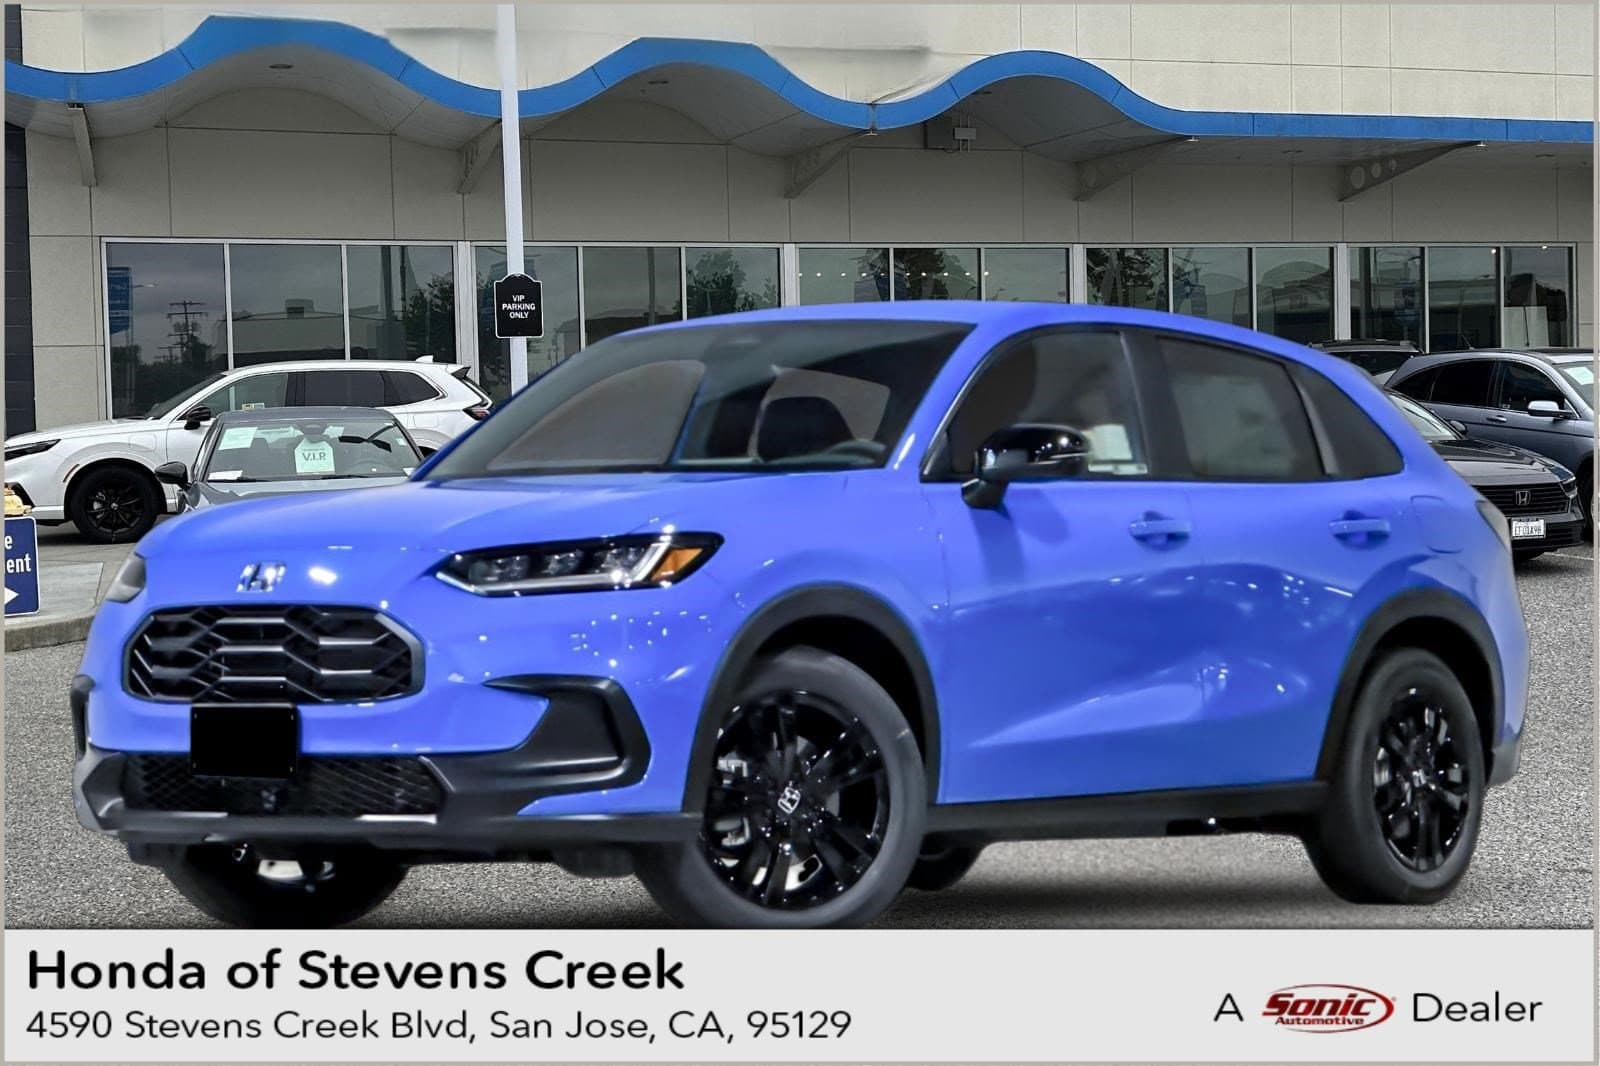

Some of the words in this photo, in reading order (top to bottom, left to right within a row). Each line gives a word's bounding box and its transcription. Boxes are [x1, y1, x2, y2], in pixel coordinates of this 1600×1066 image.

[512, 294, 525, 302] VIP
[502, 303, 536, 311] PARKING
[509, 311, 529, 319] ONLY
